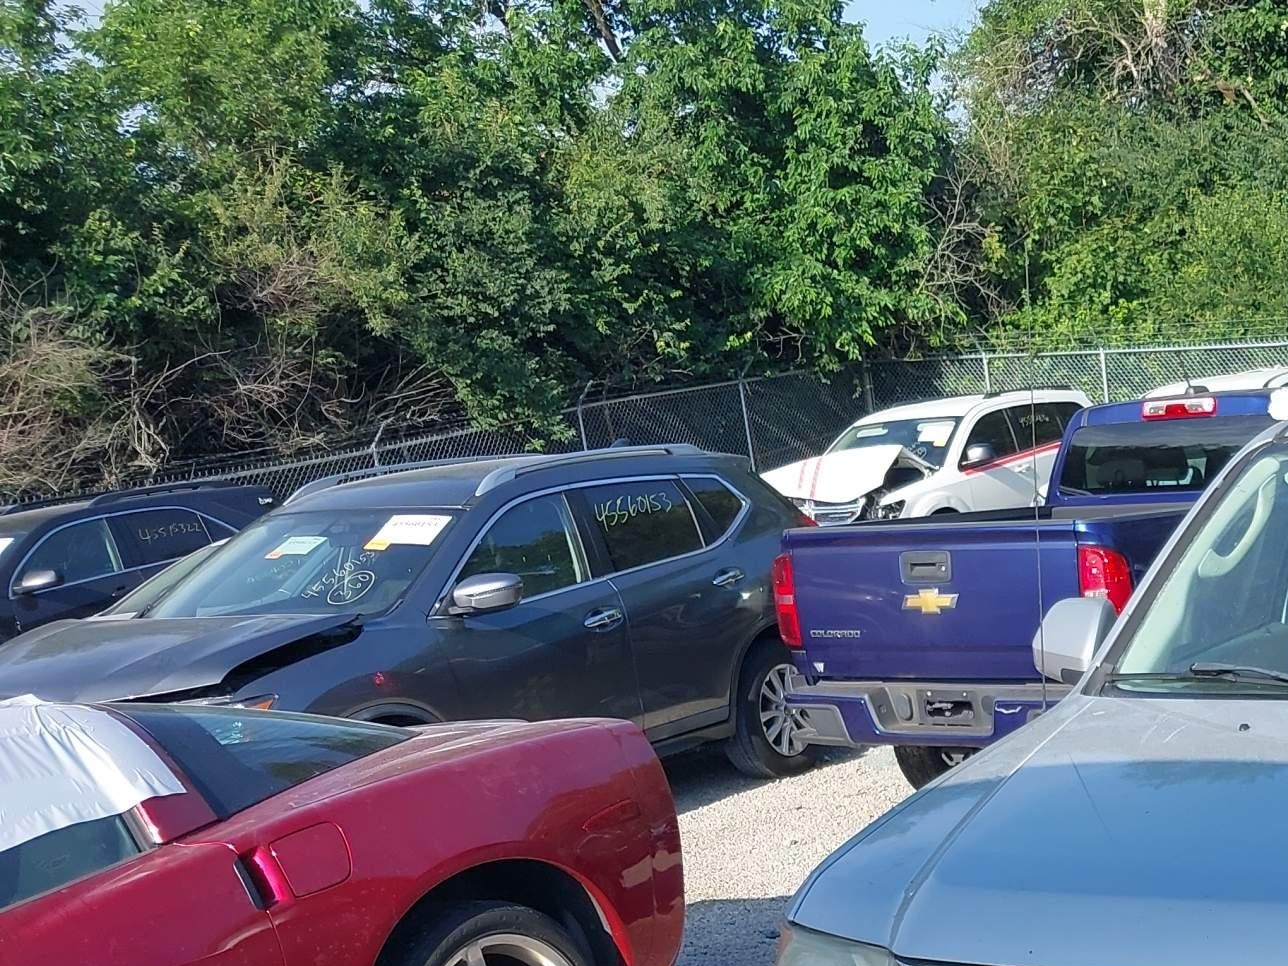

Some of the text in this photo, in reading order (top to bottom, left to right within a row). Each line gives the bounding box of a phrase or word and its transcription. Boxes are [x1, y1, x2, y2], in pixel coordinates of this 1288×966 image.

[594, 492, 672, 532] 45560153
[301, 551, 375, 599] 45560153
[810, 629, 861, 638] COLORADO
